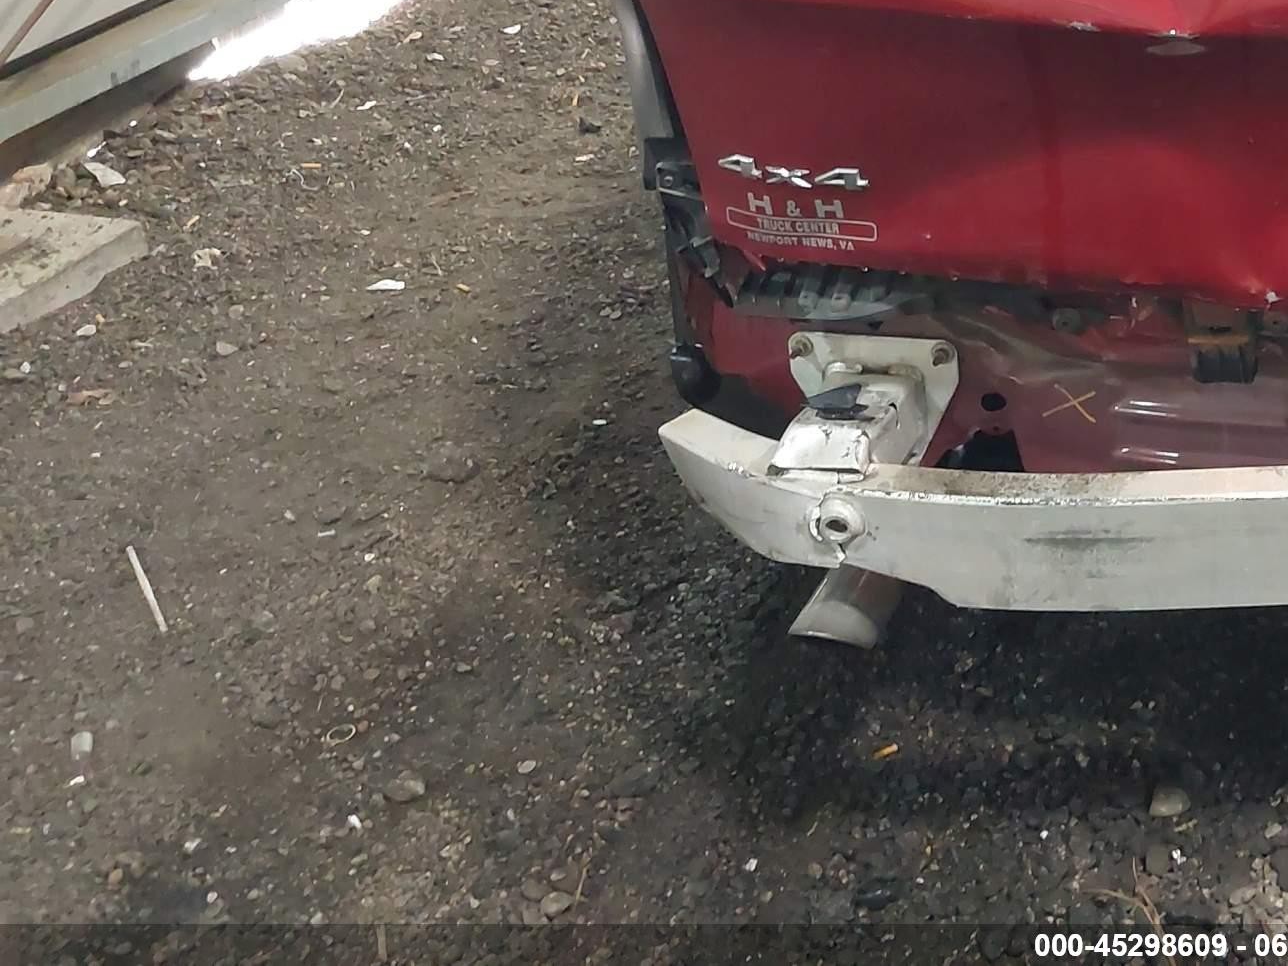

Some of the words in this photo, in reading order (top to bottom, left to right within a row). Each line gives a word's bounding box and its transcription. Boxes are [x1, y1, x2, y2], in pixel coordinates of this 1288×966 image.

[747, 192, 773, 215] H
[786, 200, 802, 217] &
[814, 199, 844, 219] H
[757, 217, 793, 231] TRUCK
[795, 220, 840, 234] CENTER
[746, 231, 798, 246] NEWPORT
[801, 237, 837, 250] NEWS,
[839, 240, 855, 251] VA
